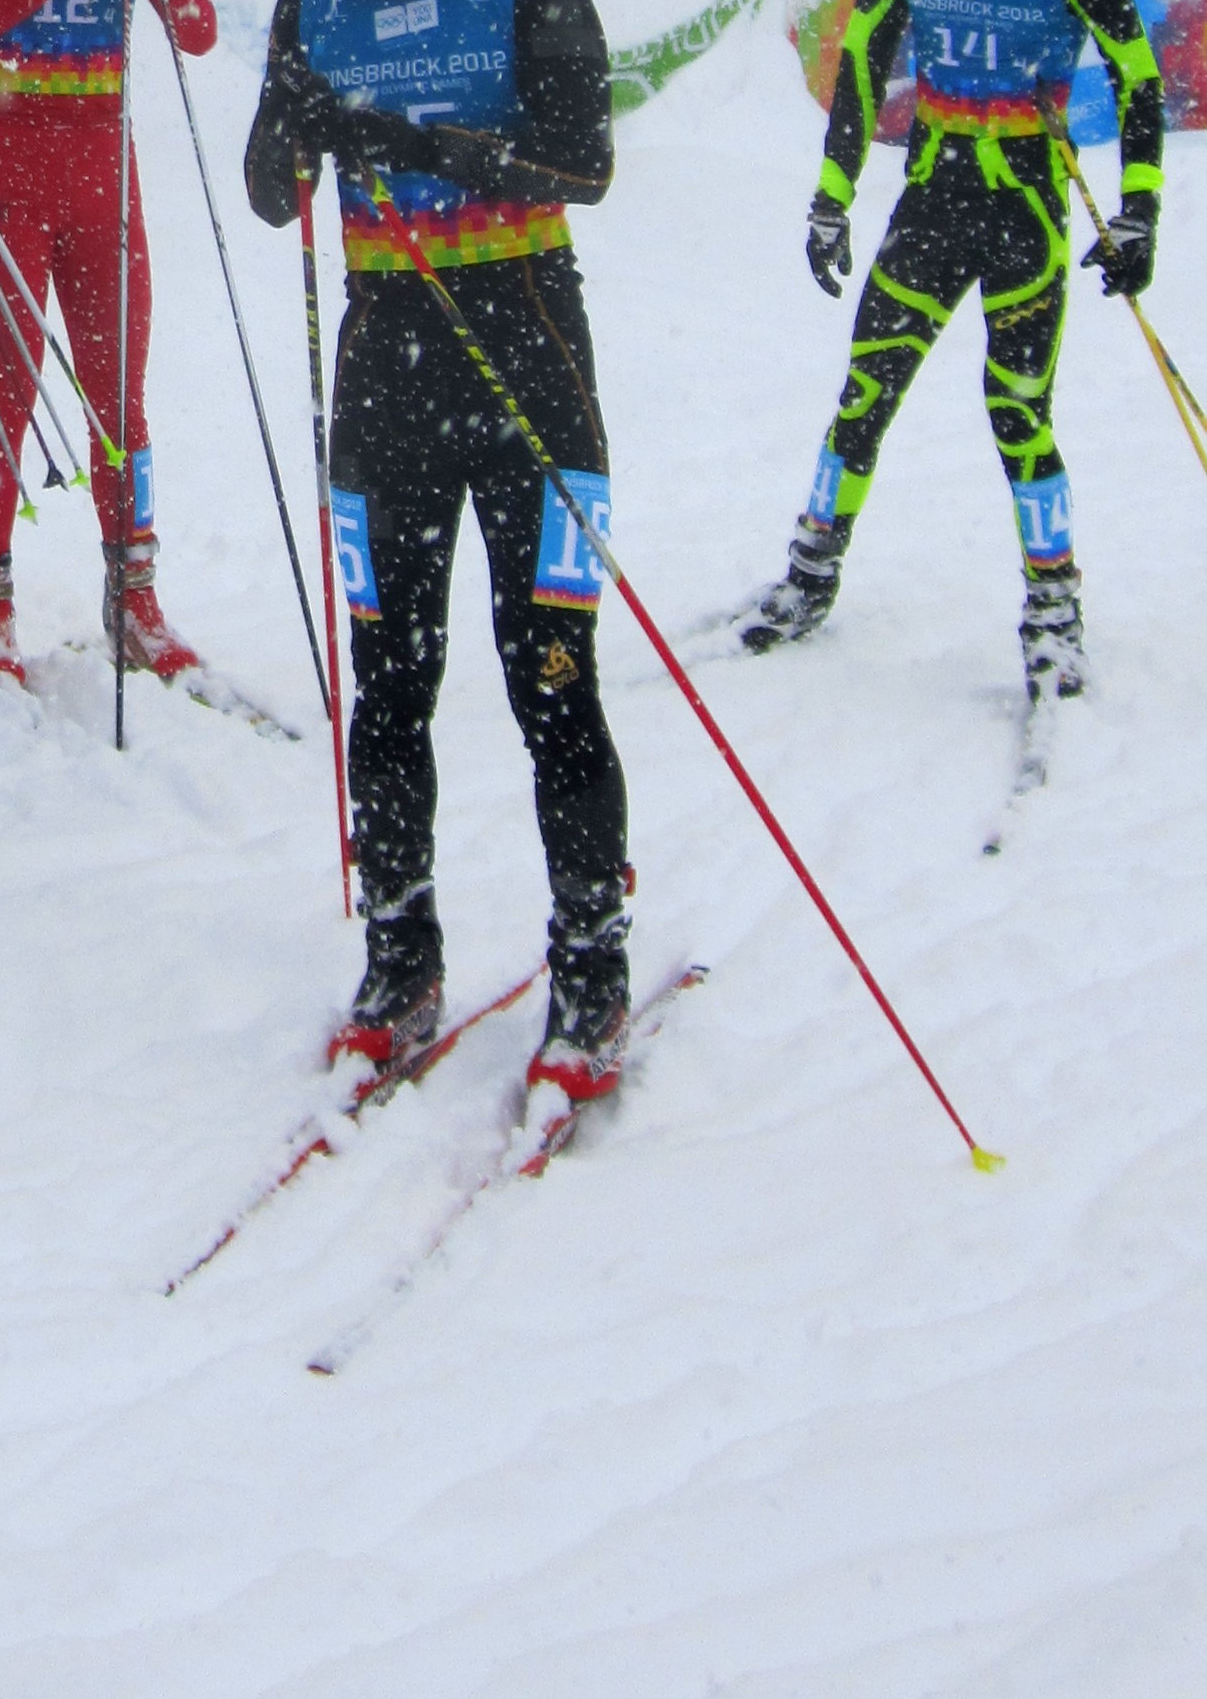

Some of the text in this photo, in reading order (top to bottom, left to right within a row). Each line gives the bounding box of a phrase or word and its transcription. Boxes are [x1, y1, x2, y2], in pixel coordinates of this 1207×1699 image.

[997, 5, 1046, 23] 2012
[933, 26, 998, 71] 14
[1020, 490, 1074, 550] 14
